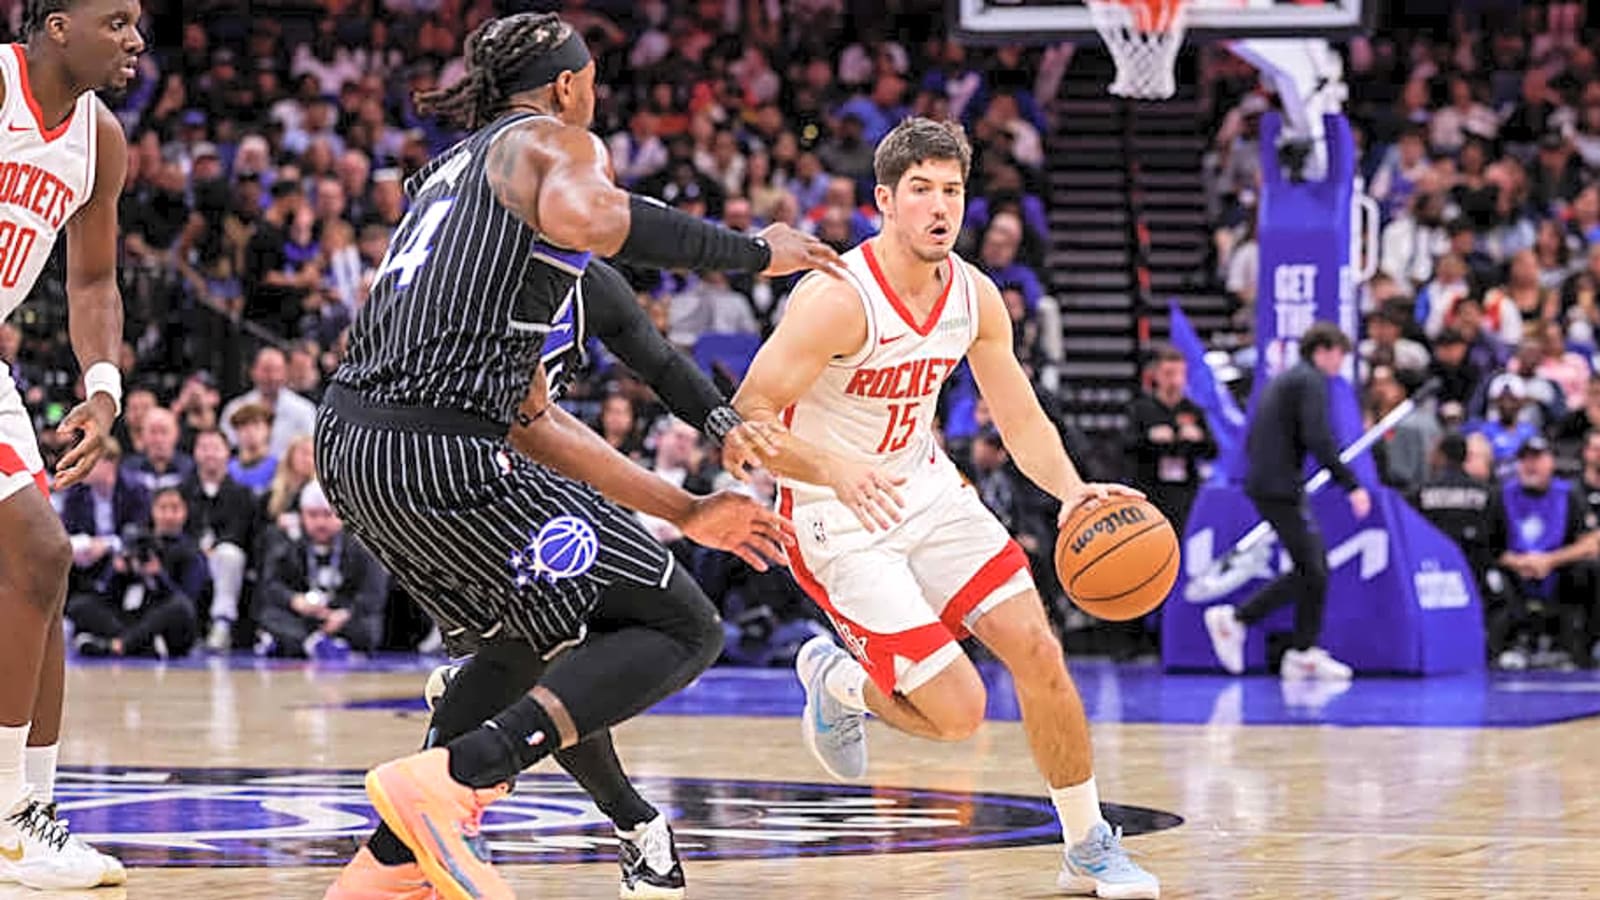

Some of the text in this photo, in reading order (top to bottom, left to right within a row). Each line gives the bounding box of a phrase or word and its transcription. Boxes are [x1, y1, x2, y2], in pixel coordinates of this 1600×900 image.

[0, 161, 75, 231] OCKETS
[1274, 264, 1318, 301] GET
[876, 401, 921, 454] 15
[1071, 506, 1145, 554] Wilson
